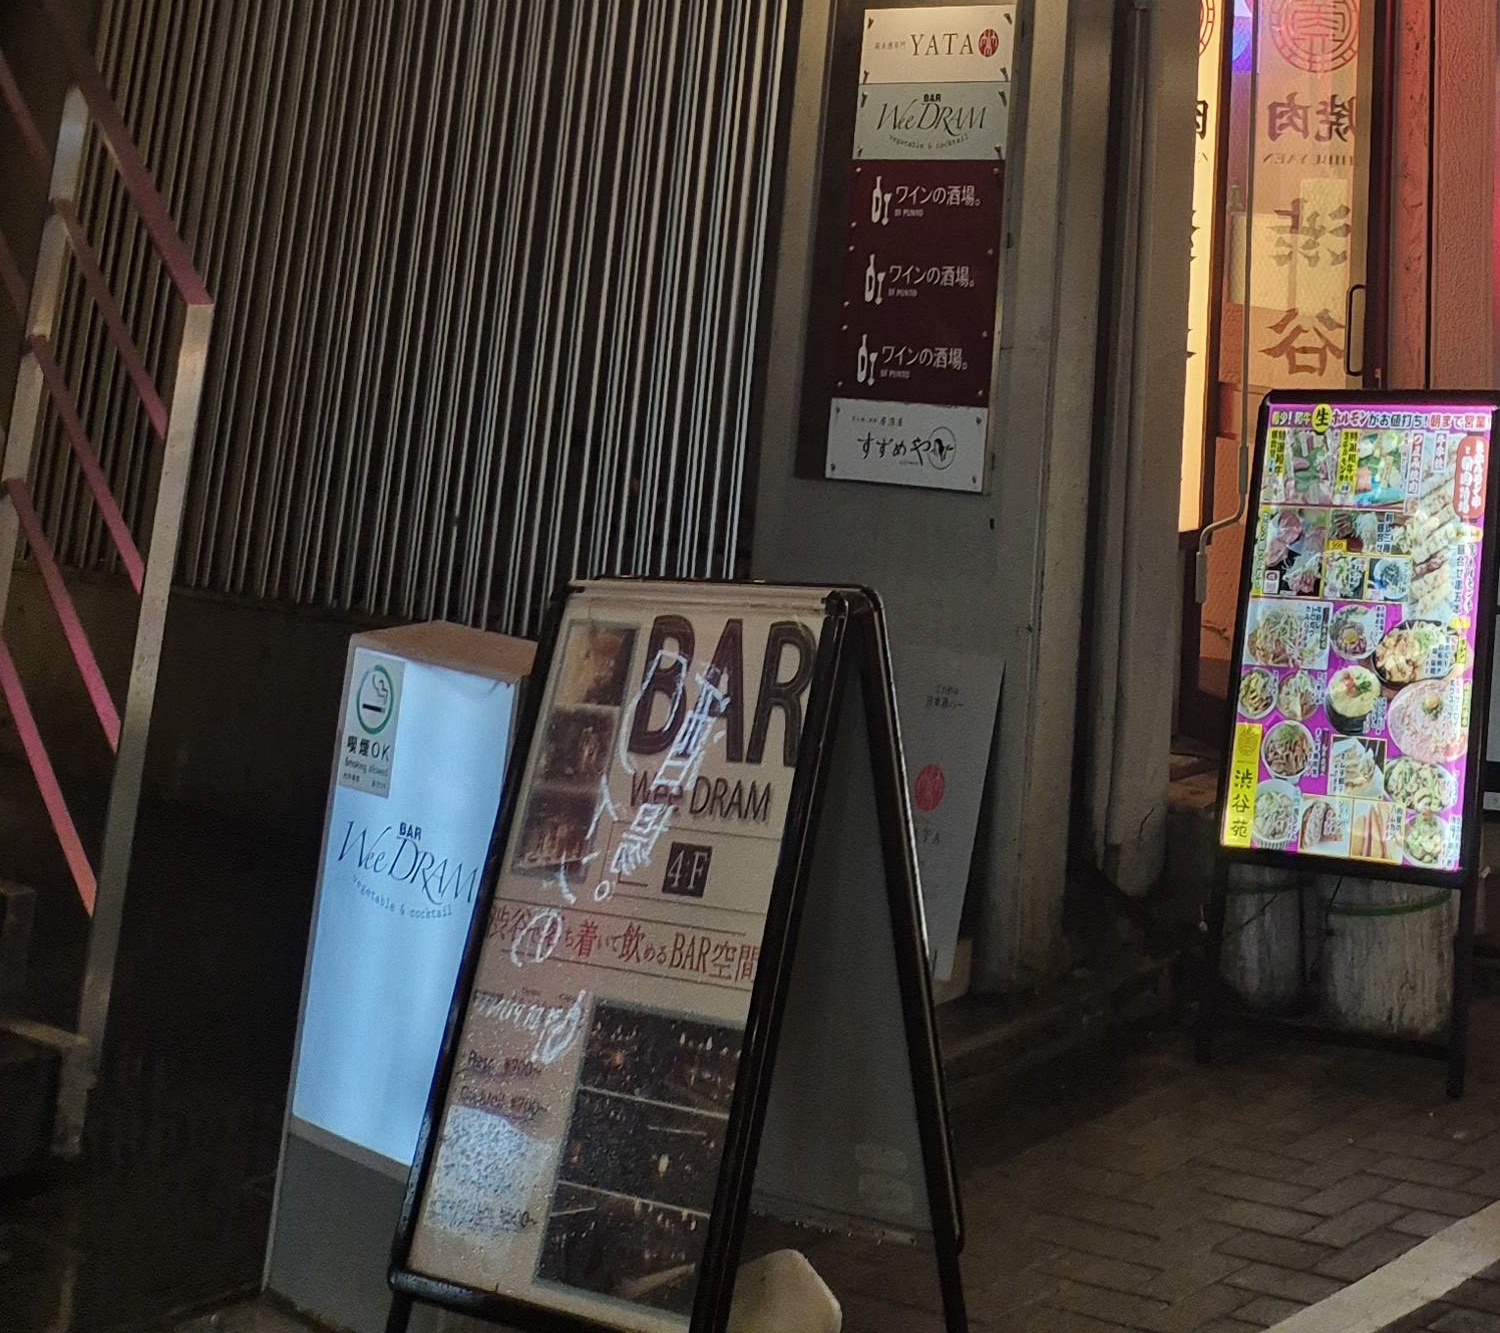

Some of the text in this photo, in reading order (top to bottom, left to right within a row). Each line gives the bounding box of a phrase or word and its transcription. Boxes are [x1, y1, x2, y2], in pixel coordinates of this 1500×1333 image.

[910, 32, 975, 57] YATA
[876, 98, 987, 137] Wee DRAM
[894, 184, 981, 207] ワインの酒場。
[888, 264, 975, 288] ワインの酒場。
[881, 345, 968, 371] ワインの酒場。
[628, 614, 820, 769] BAR
[346, 734, 392, 763] 喫煙OK
[688, 774, 773, 822] DRAM
[1229, 767, 1251, 839] 渋谷苑
[399, 820, 423, 841] BAR
[337, 819, 479, 906] Wee DRAM
[666, 846, 710, 897] 4F
[410, 902, 453, 920] cocktail
